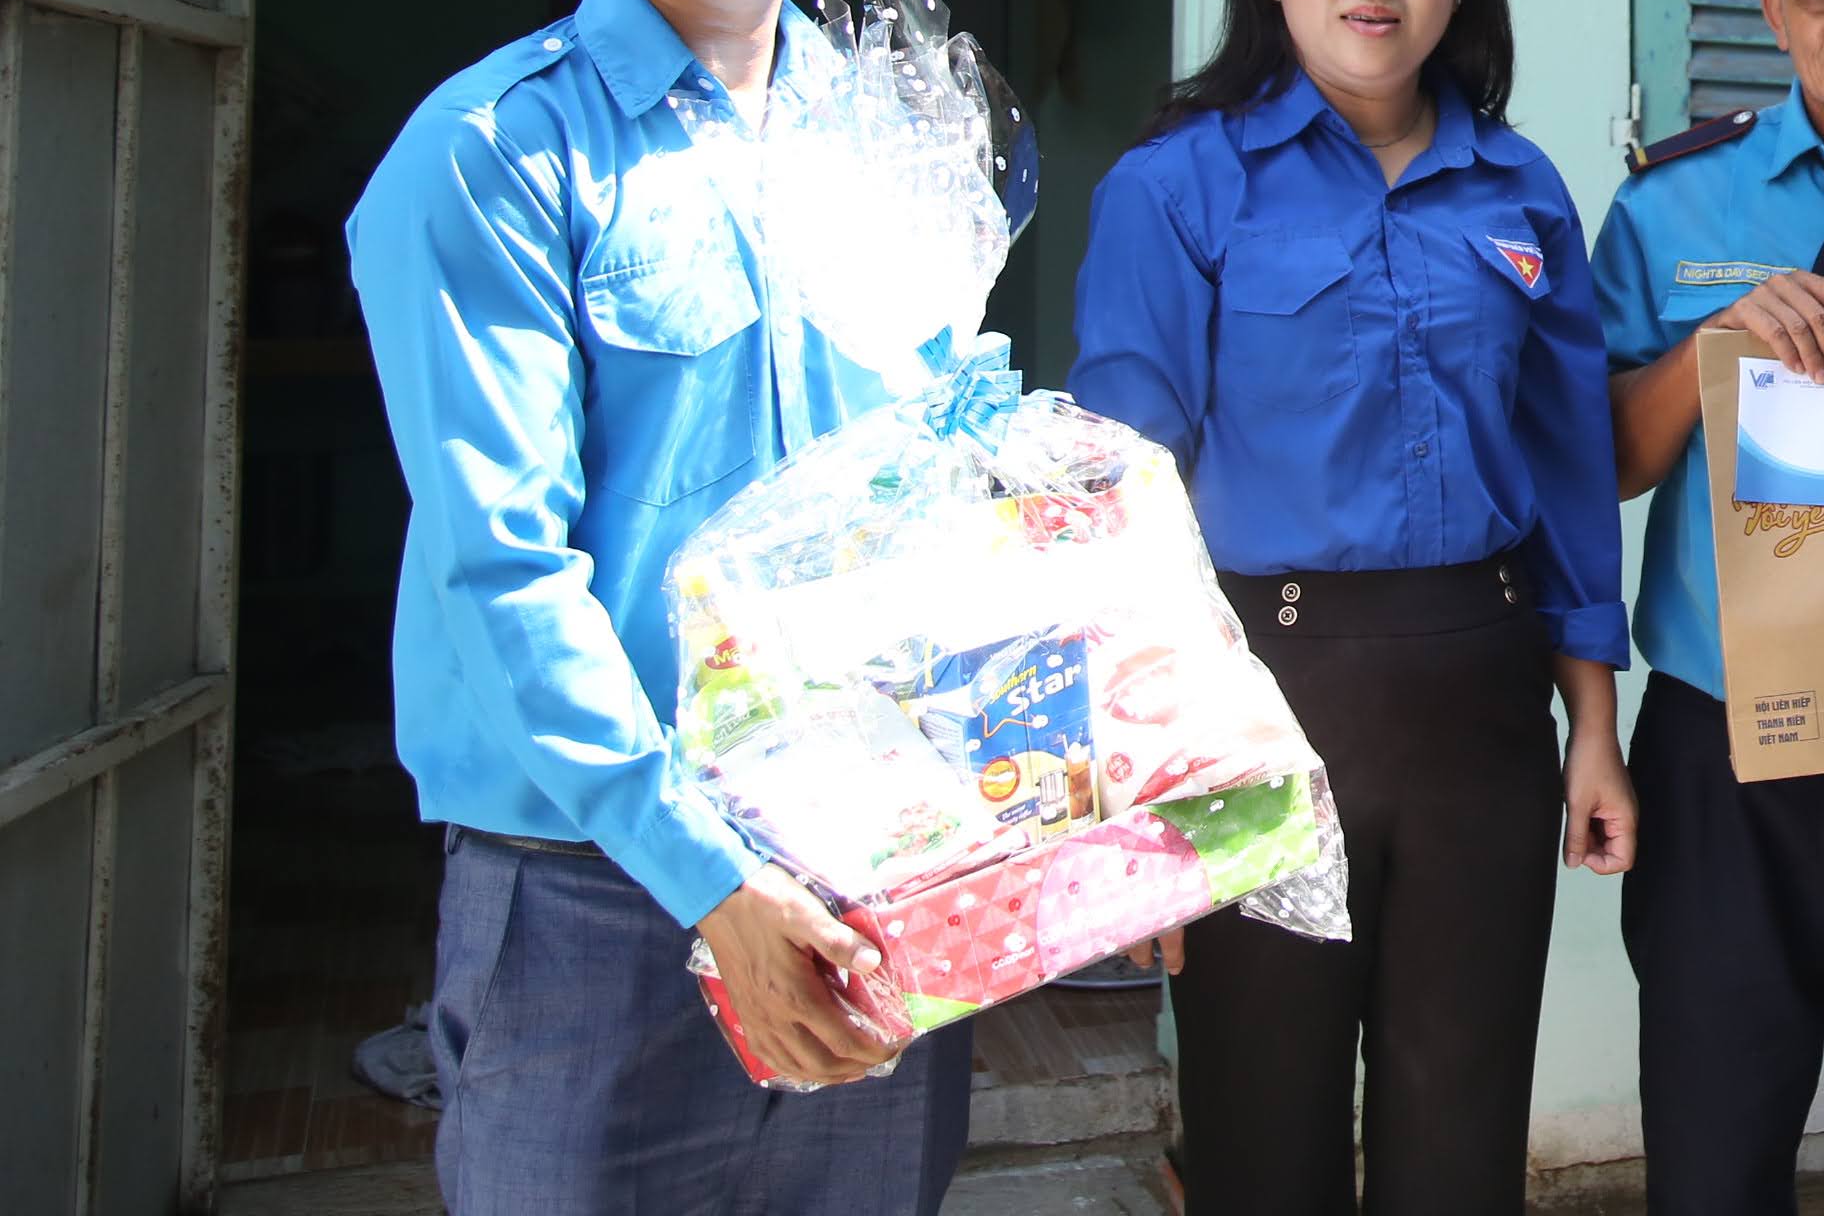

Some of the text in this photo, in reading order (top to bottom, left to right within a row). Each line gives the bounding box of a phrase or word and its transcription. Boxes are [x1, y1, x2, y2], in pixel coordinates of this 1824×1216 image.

[1724, 268, 1745, 278] DAY
[1007, 664, 1081, 716] Star
[1757, 717, 1785, 730] THANH
[1778, 731, 1799, 744] NAM
